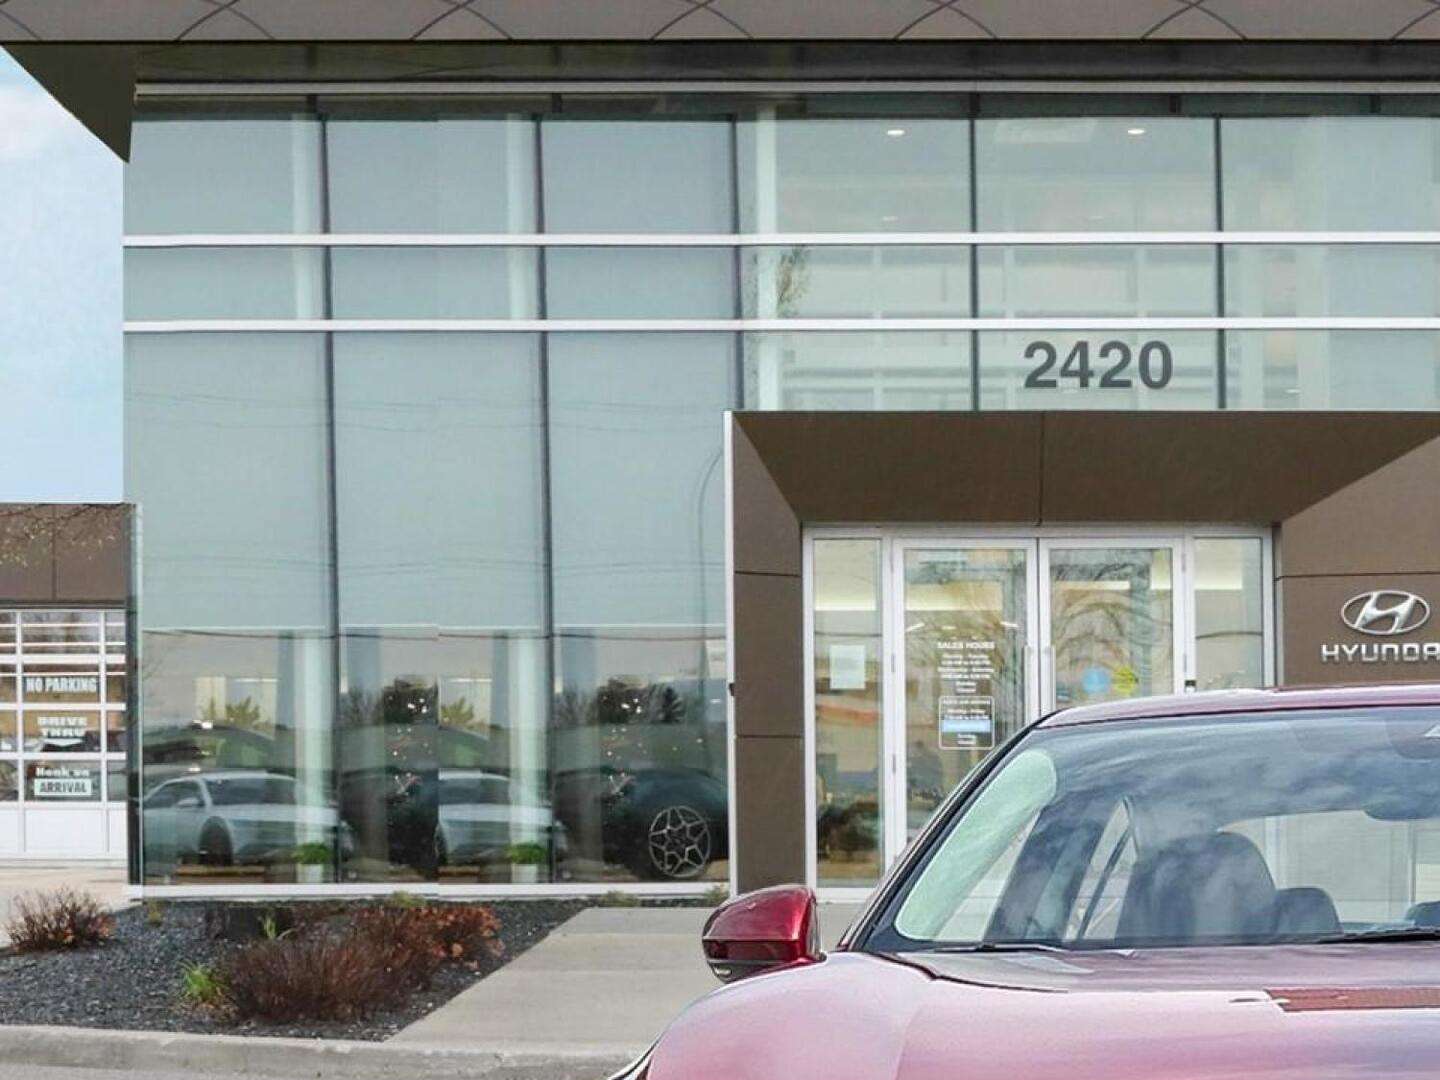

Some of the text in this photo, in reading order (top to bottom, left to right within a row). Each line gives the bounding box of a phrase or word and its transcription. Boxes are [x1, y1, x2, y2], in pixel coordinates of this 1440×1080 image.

[1024, 340, 1173, 389] 2420
[26, 677, 97, 692] NO PARKING
[37, 716, 87, 726] DRIVE
[41, 728, 86, 737] THRU
[40, 782, 87, 793] ARRIVAL
